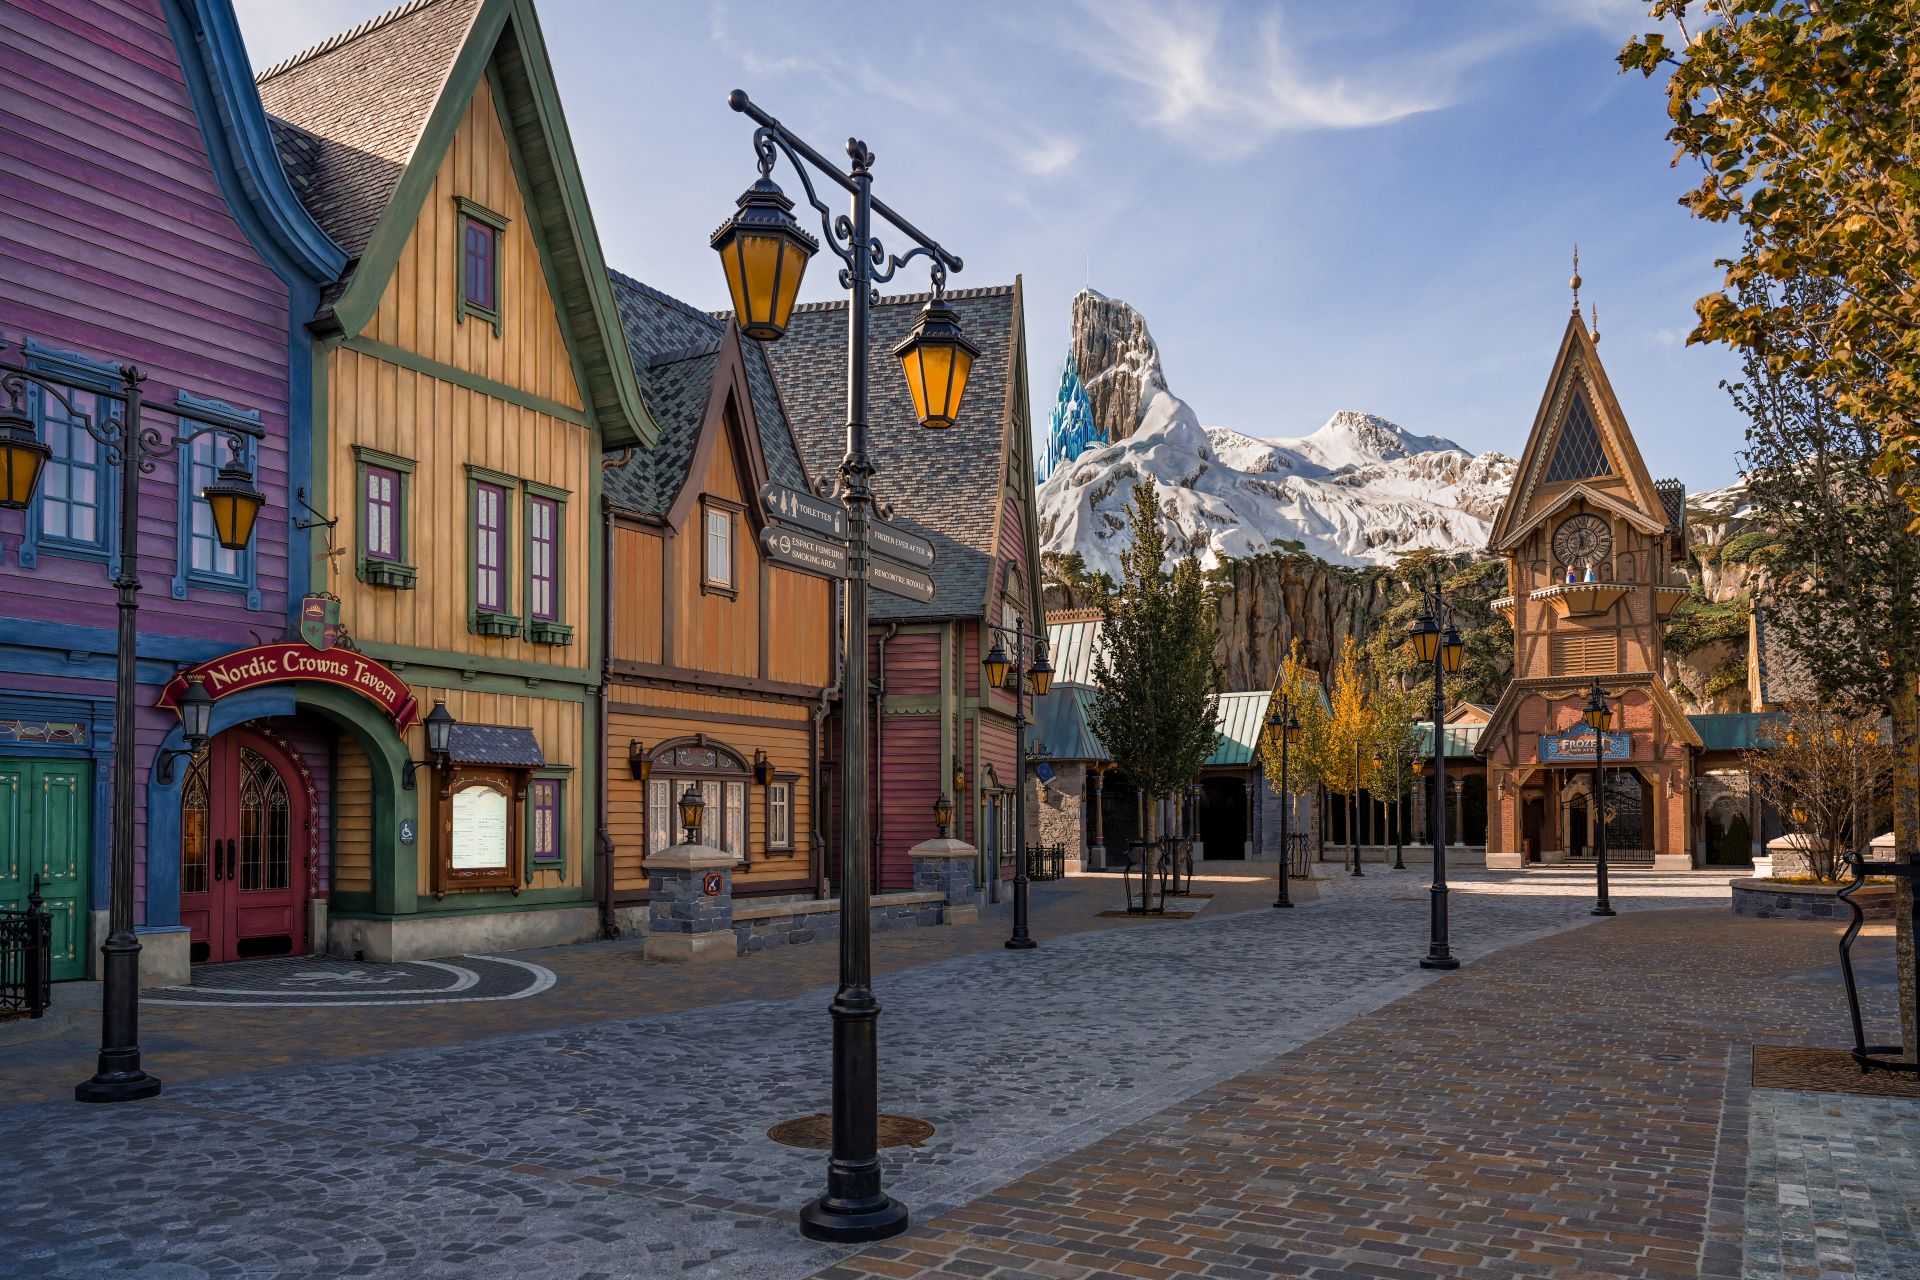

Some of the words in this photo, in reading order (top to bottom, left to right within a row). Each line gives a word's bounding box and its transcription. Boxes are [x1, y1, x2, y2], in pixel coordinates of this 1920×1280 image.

[799, 504, 832, 522] TOILETTES
[792, 537, 814, 551] ESPACE
[815, 545, 844, 559] FUMEURS
[874, 531, 895, 545] FROZEN
[895, 539, 909, 549] EVER
[909, 545, 926, 556] AFTER
[791, 550, 820, 565] SMOKING
[820, 559, 837, 570] AREA
[874, 568, 906, 585] RENCONTRE
[906, 578, 925, 590] ROYALE
[208, 656, 277, 690] Nordic
[282, 651, 348, 677] Crowns
[354, 660, 397, 703] Tavern
